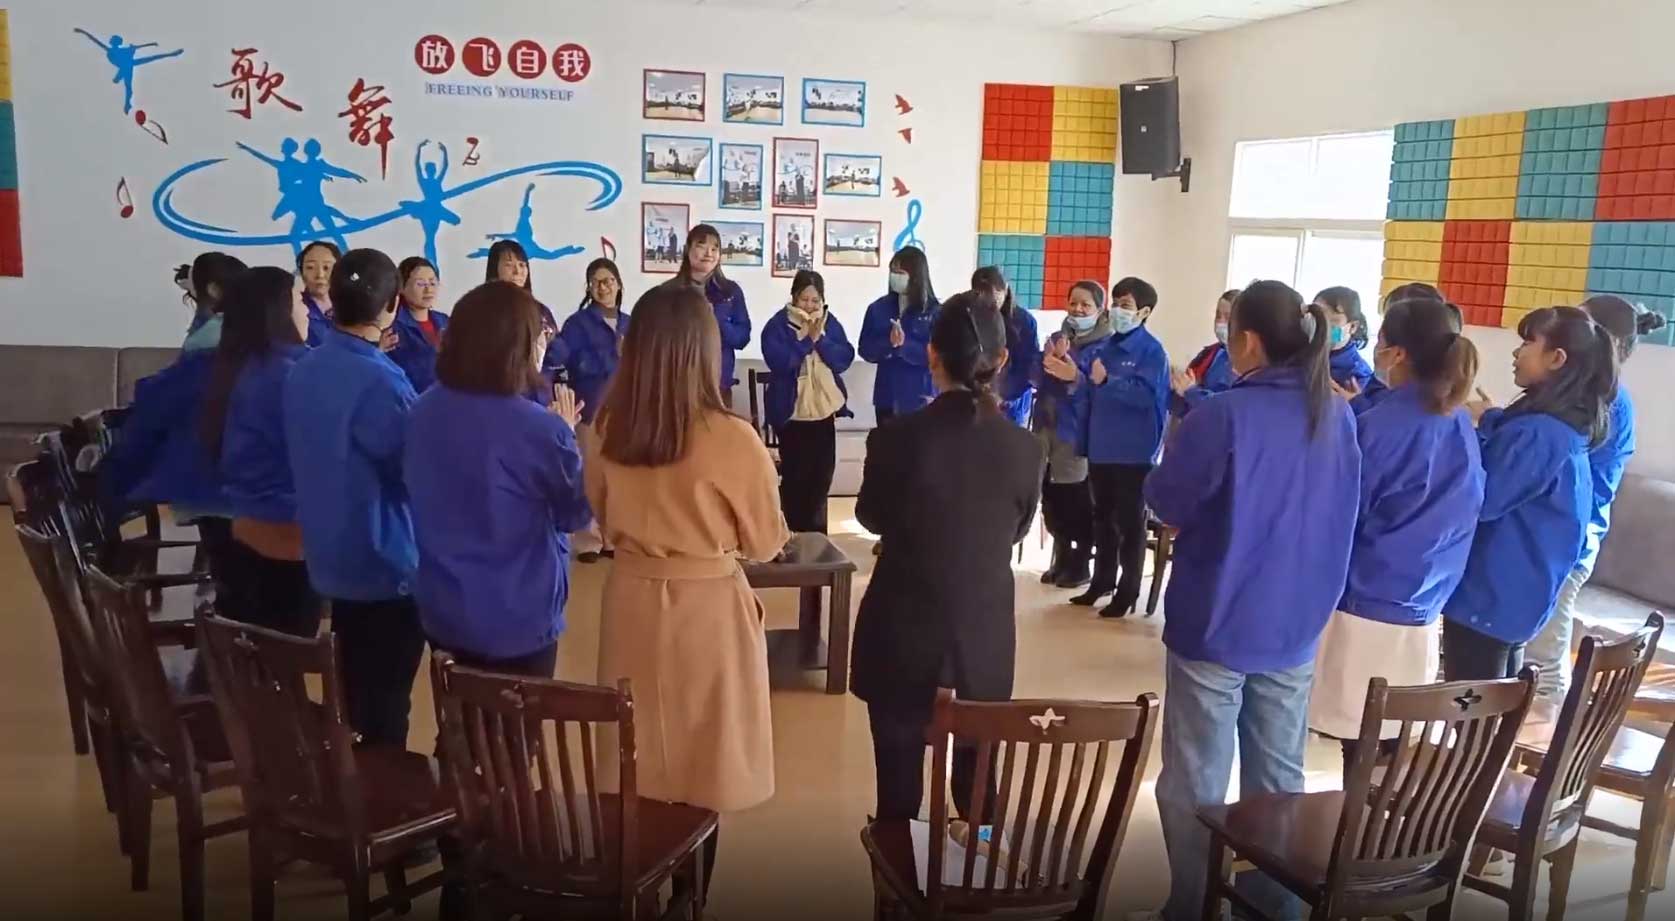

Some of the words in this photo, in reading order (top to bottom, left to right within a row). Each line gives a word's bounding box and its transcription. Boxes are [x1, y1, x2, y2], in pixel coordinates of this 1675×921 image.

[419, 39, 586, 78] 放飞自我
[426, 82, 493, 97] FREEING
[497, 84, 574, 101] YOURSELF
